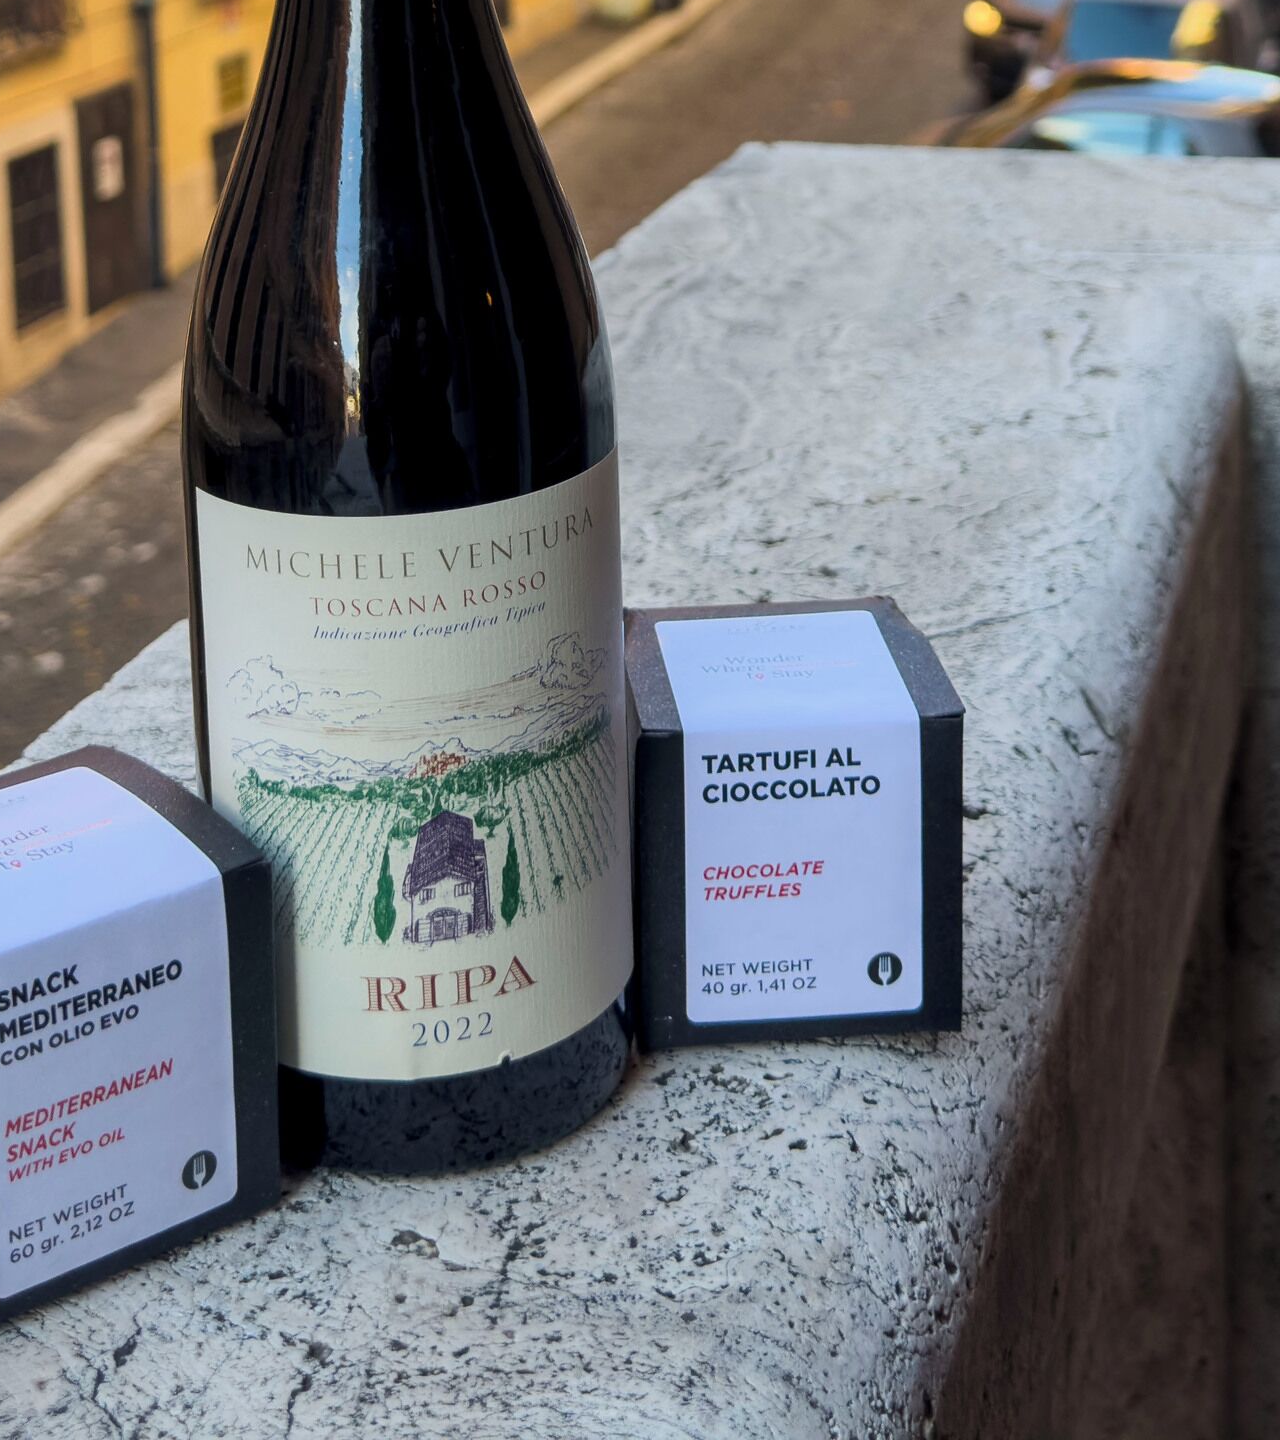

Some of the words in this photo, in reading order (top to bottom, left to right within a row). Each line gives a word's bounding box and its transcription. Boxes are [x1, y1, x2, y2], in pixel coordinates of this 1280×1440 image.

[246, 543, 417, 581] MICHELE
[437, 506, 594, 574] VENTURA
[308, 594, 448, 618] TOSCANA
[462, 570, 546, 608] ROSSO
[313, 624, 408, 641] Indicazione
[412, 613, 499, 638] Geografica
[504, 600, 546, 624] Tipica
[701, 750, 818, 775] TARTUFI
[824, 747, 862, 768] AL
[701, 775, 881, 804] CIOCCOLATO
[26, 840, 74, 862] Stay
[702, 860, 825, 882] CHOCOLATE
[703, 882, 803, 901] TRUFFLES
[359, 954, 539, 1012] RIPA
[701, 961, 735, 977] NET
[742, 958, 814, 974] WEIGHT
[701, 980, 725, 995] 40
[730, 980, 753, 997] gr.
[757, 977, 787, 996] 1,41
[791, 975, 818, 990] OZ
[0, 1038, 44, 1066] CON
[48, 1020, 96, 1048] OLIO
[100, 1003, 140, 1030] EVO
[411, 1011, 494, 1048] 2022
[4, 1057, 174, 1139] MEDITERRANEAN
[6, 1120, 77, 1164] SNACK
[8, 1154, 55, 1183] WITH
[58, 1140, 94, 1165] EVO
[98, 1127, 126, 1147] OIL
[8, 1216, 48, 1245] NET
[52, 1182, 128, 1226] WEIGHT
[9, 1242, 35, 1264] 60
[40, 1234, 65, 1254] gr.
[70, 1215, 104, 1241] 2,12
[108, 1200, 136, 1223] OZ
